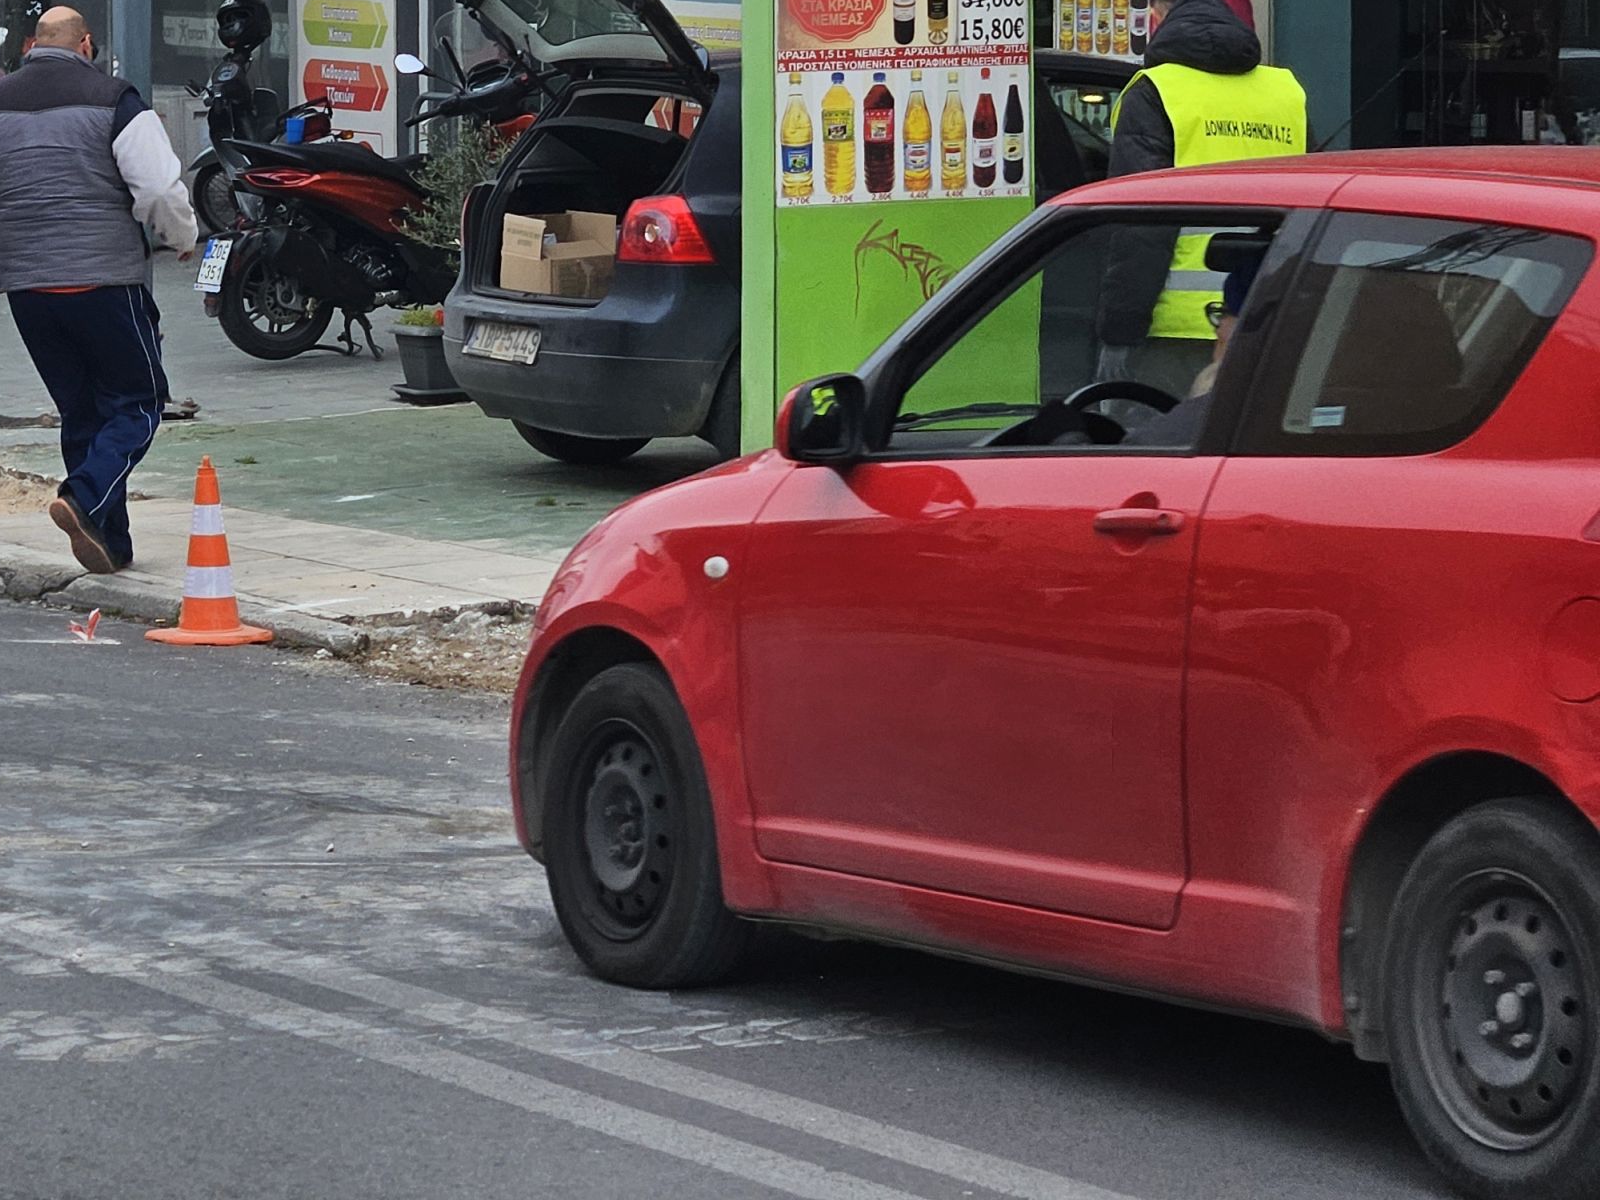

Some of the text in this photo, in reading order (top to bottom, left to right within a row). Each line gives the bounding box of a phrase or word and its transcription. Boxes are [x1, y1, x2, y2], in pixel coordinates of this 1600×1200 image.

[801, 0, 825, 13] ΣΤΑ
[812, 13, 864, 26] ΝΕΜΕΑΣ
[960, 17, 1025, 45] 15,80€
[778, 50, 816, 61] ΚΡΑΣΙΑ
[819, 50, 834, 60] 1,5
[855, 48, 896, 58] ΝΕΜΕΑΣ
[904, 47, 945, 57] ΑΡΧΑΙΑΣ
[788, 59, 893, 71] ΠΡΟΣΤΑΤΕΥΟΜΕΝΗΣ
[894, 58, 959, 69] ΓΕΩΓΡΑΦΙΚΗΣ
